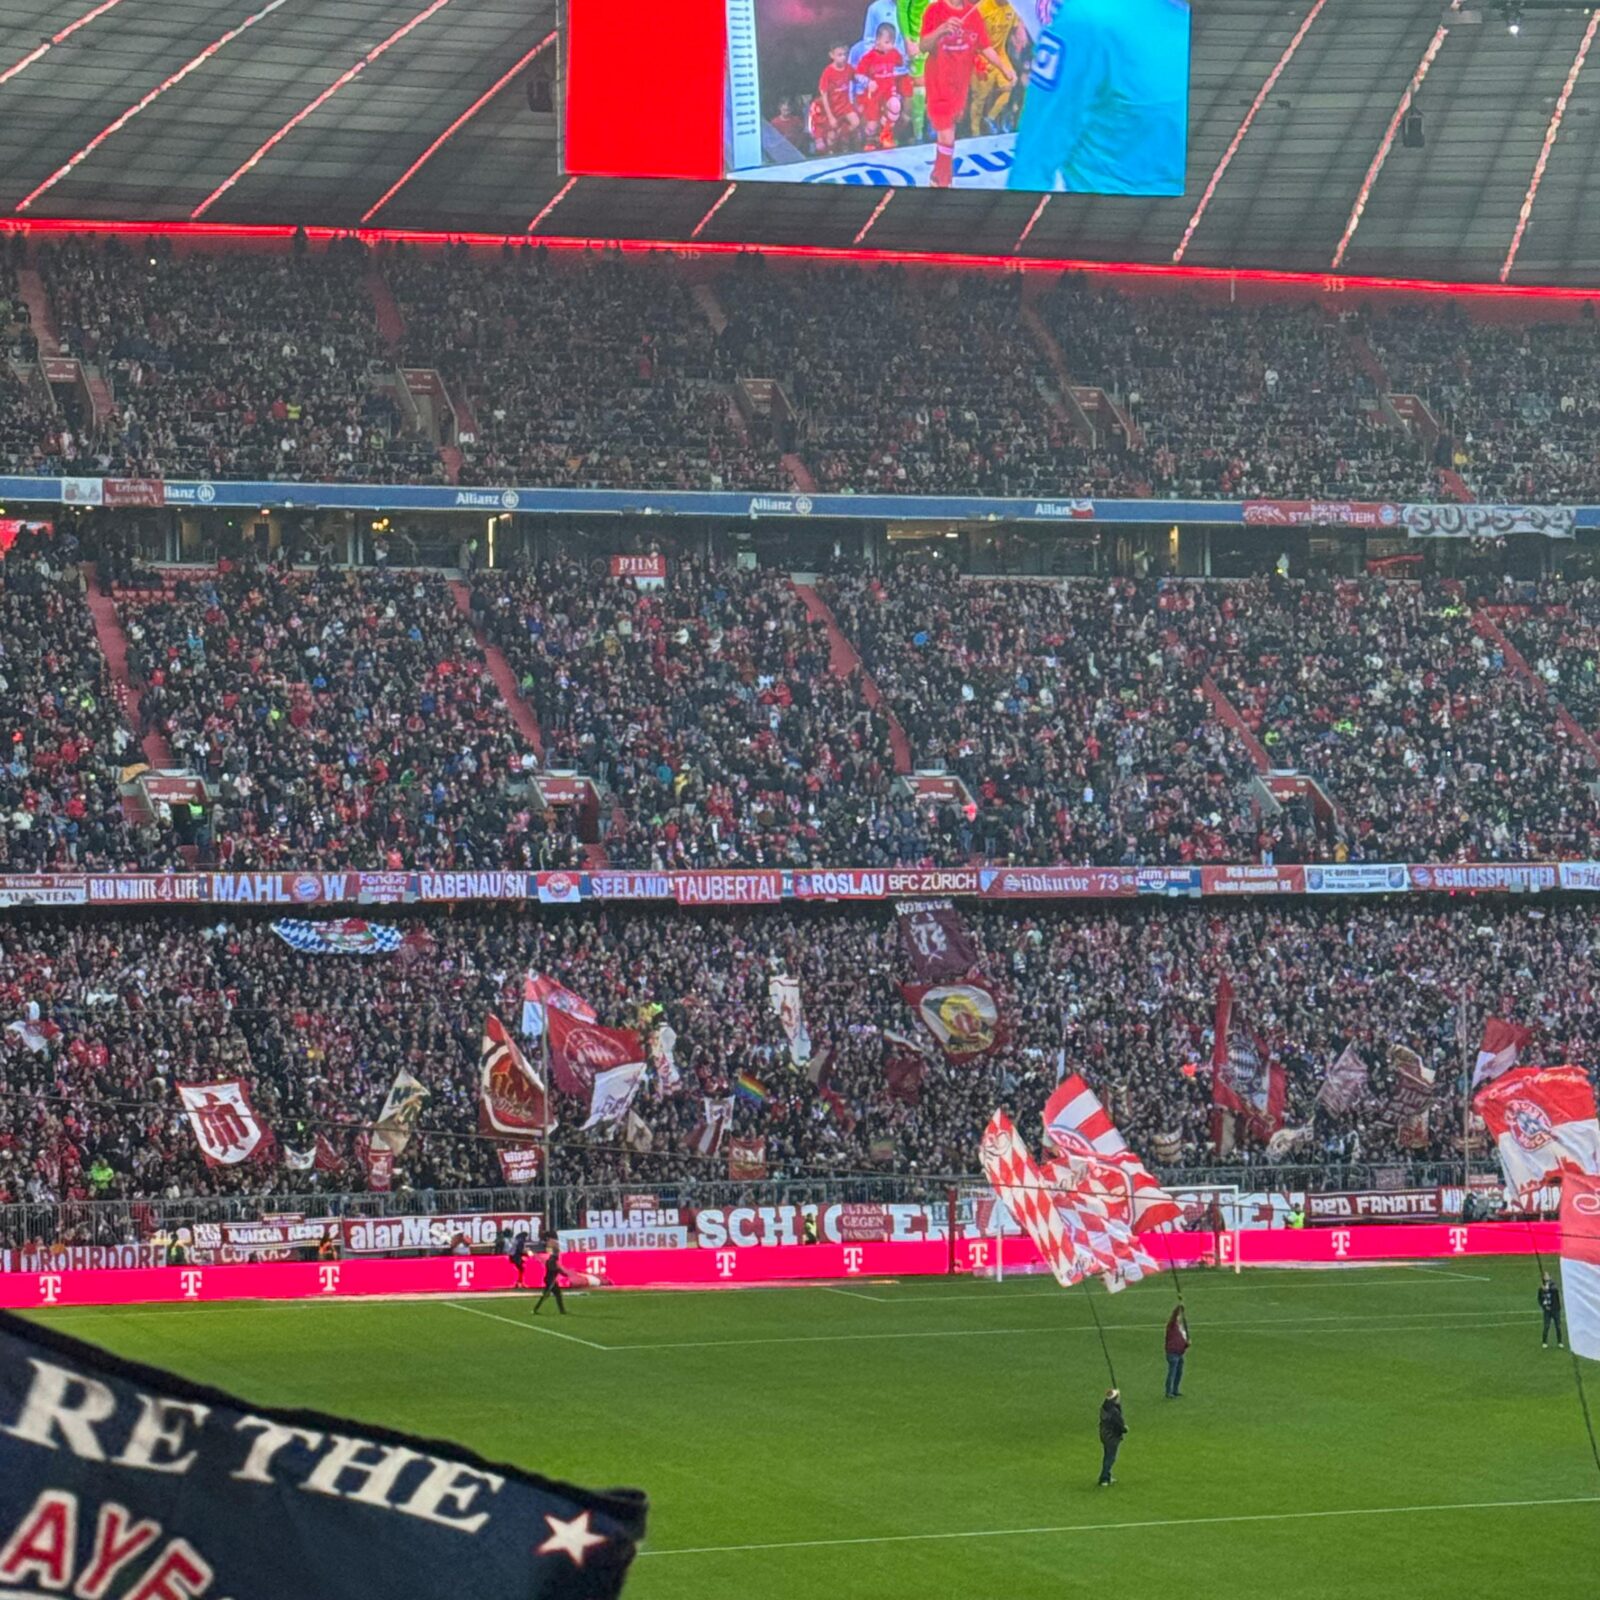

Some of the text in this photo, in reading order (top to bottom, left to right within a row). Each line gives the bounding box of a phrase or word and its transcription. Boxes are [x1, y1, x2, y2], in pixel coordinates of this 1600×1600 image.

[456, 492, 499, 505] Allianz
[750, 498, 792, 511] Allianz
[591, 876, 670, 899] SEELAND
[676, 876, 781, 901] TAUBERTAL
[888, 874, 919, 891] BFC
[229, 1415, 506, 1534] THE
